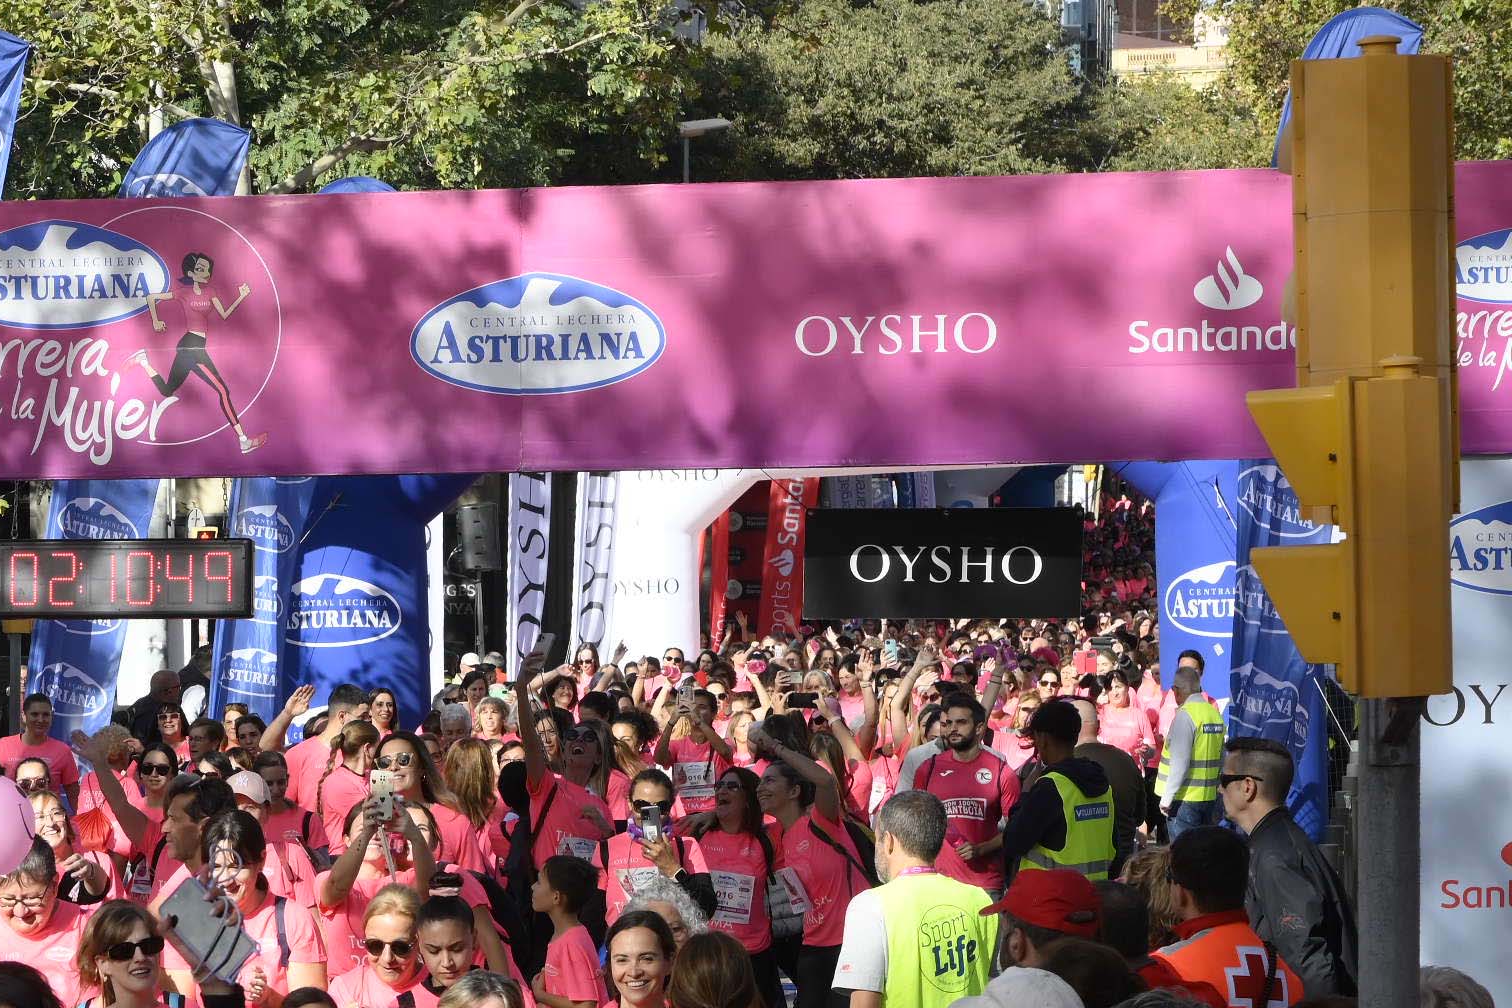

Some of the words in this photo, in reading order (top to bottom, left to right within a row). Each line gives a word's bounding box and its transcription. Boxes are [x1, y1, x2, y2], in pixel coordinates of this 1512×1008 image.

[72, 255, 145, 268] LECHERA
[470, 316, 549, 328] CENTRAL
[556, 313, 637, 326] LECHERA
[794, 312, 997, 357] OYSHO
[430, 320, 645, 364] ASTURIANA
[1478, 338, 1496, 367] la
[10, 380, 37, 421] la
[31, 372, 180, 466] Mujer
[10, 551, 232, 606] 02:10:49
[849, 544, 1044, 585] OYSHO
[338, 598, 388, 608] LECHERA
[921, 911, 968, 948] Sport
[932, 934, 976, 977] Life
